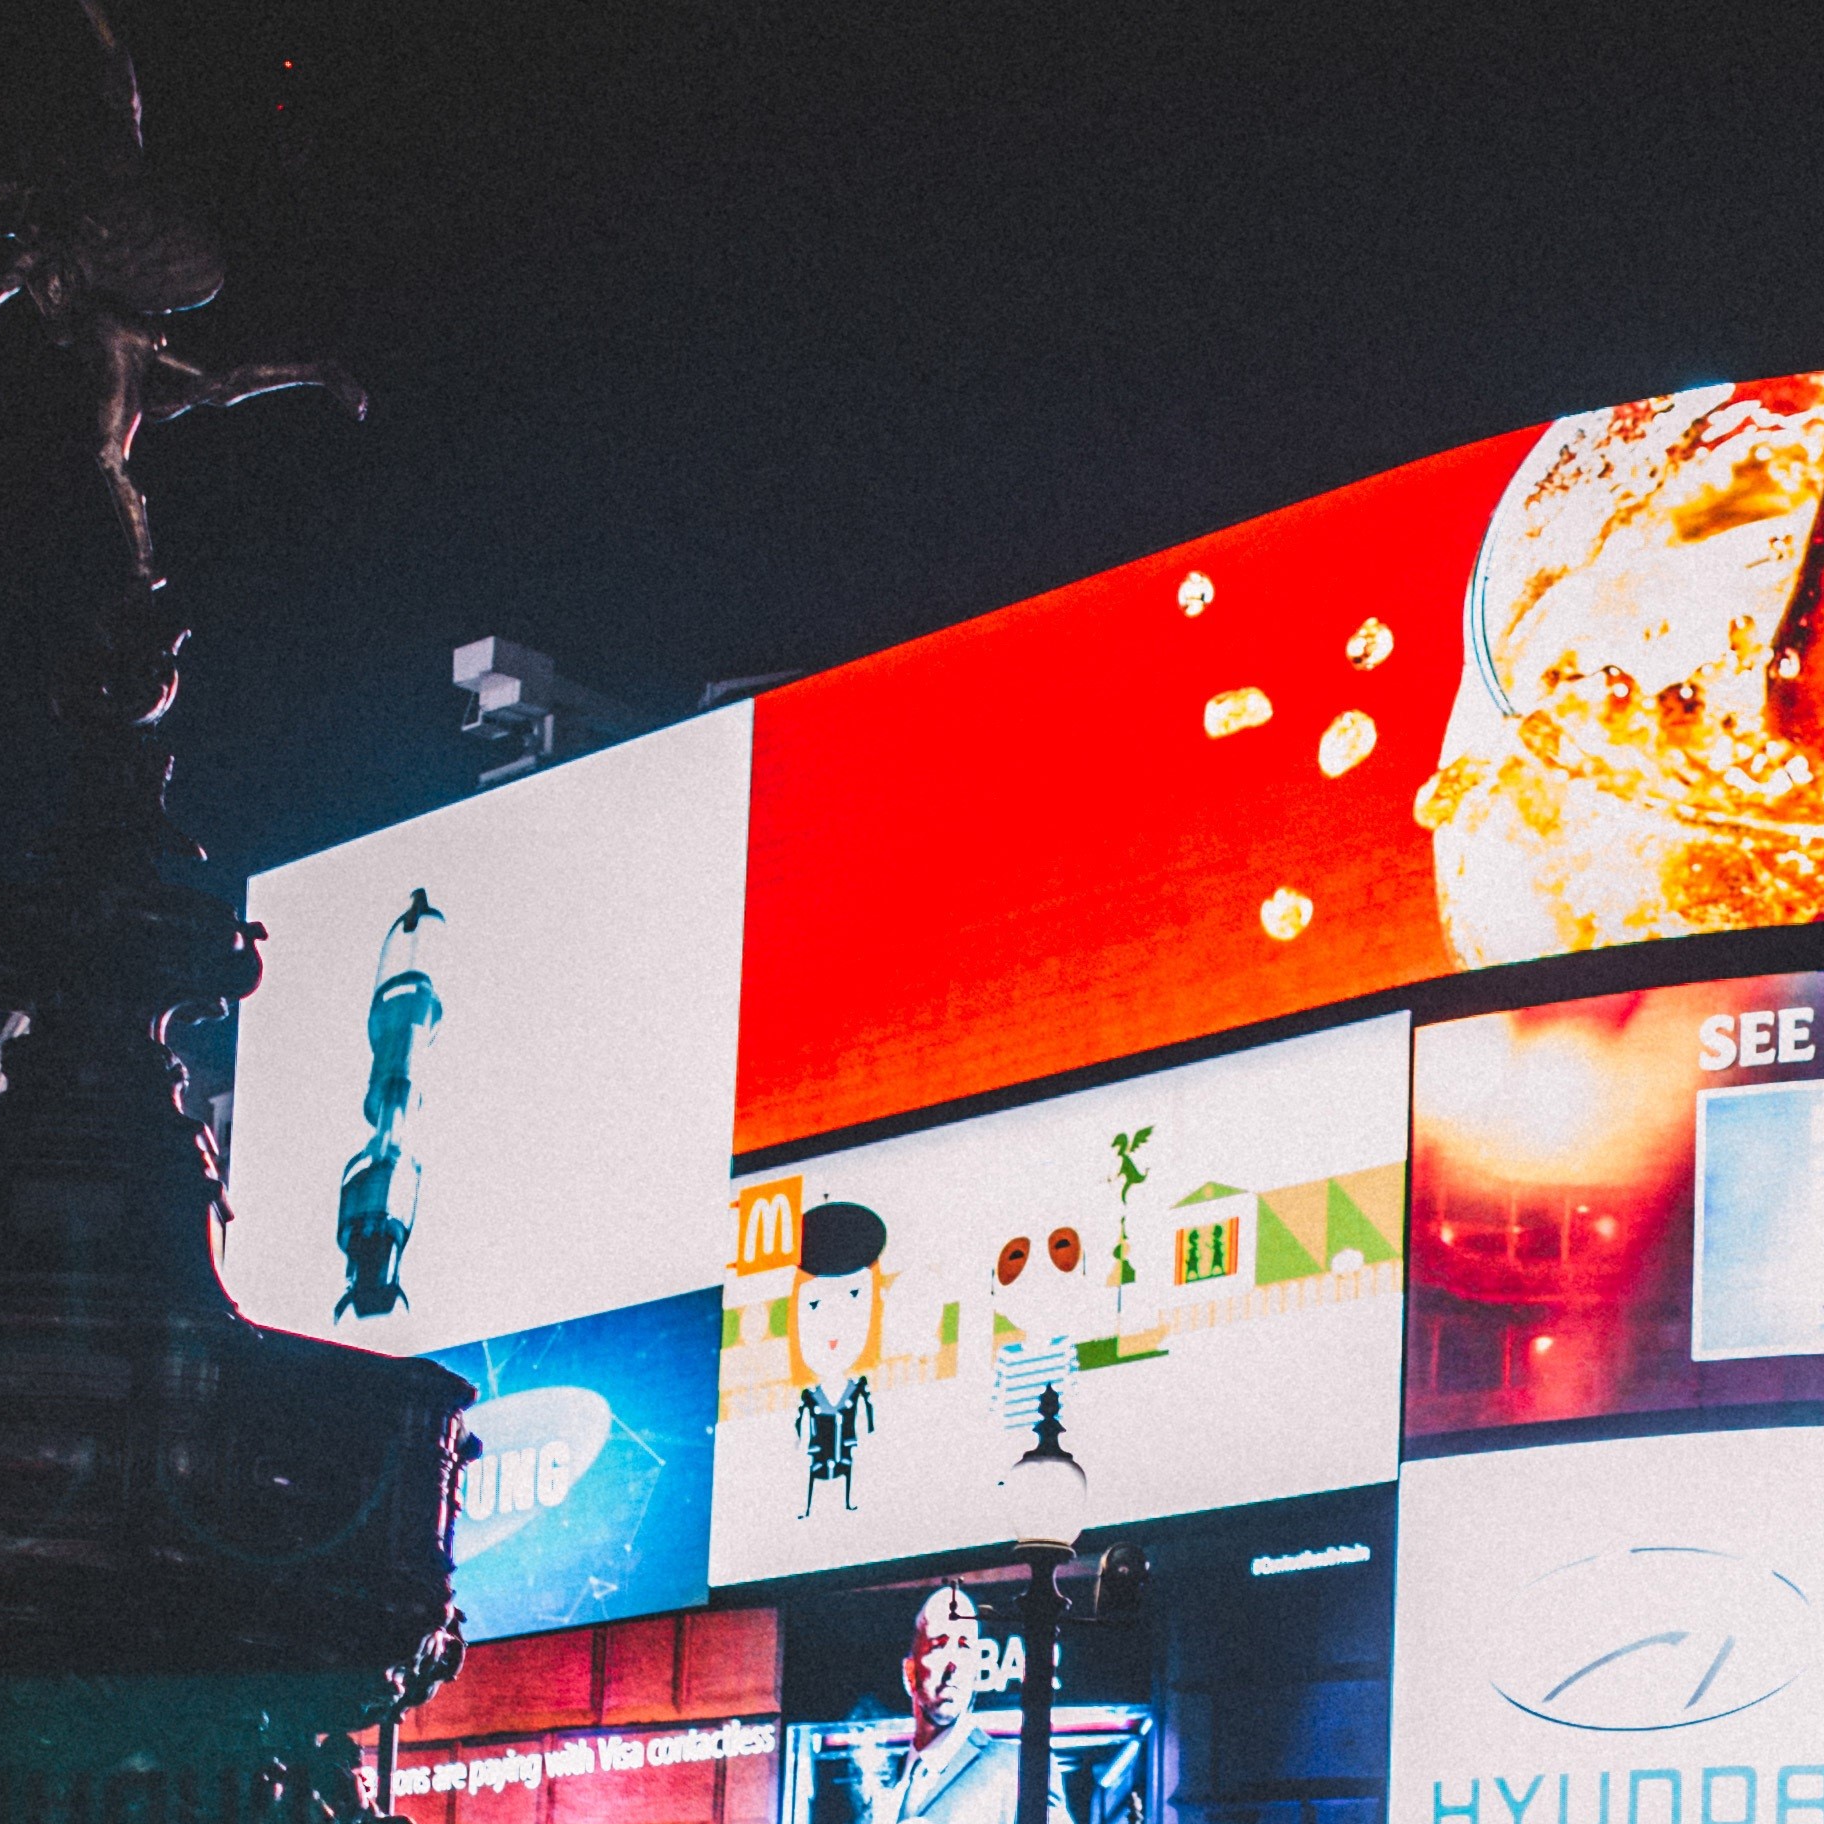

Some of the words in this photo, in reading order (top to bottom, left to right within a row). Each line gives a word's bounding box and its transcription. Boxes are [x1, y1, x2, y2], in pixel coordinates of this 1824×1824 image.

[1697, 1006, 1817, 1072] SEE
[454, 1440, 572, 1521] UNG
[432, 1761, 468, 1793] are
[468, 1749, 544, 1797] paying
[544, 1740, 595, 1778] with
[597, 1735, 646, 1773] Visa
[647, 1718, 776, 1767] contactless
